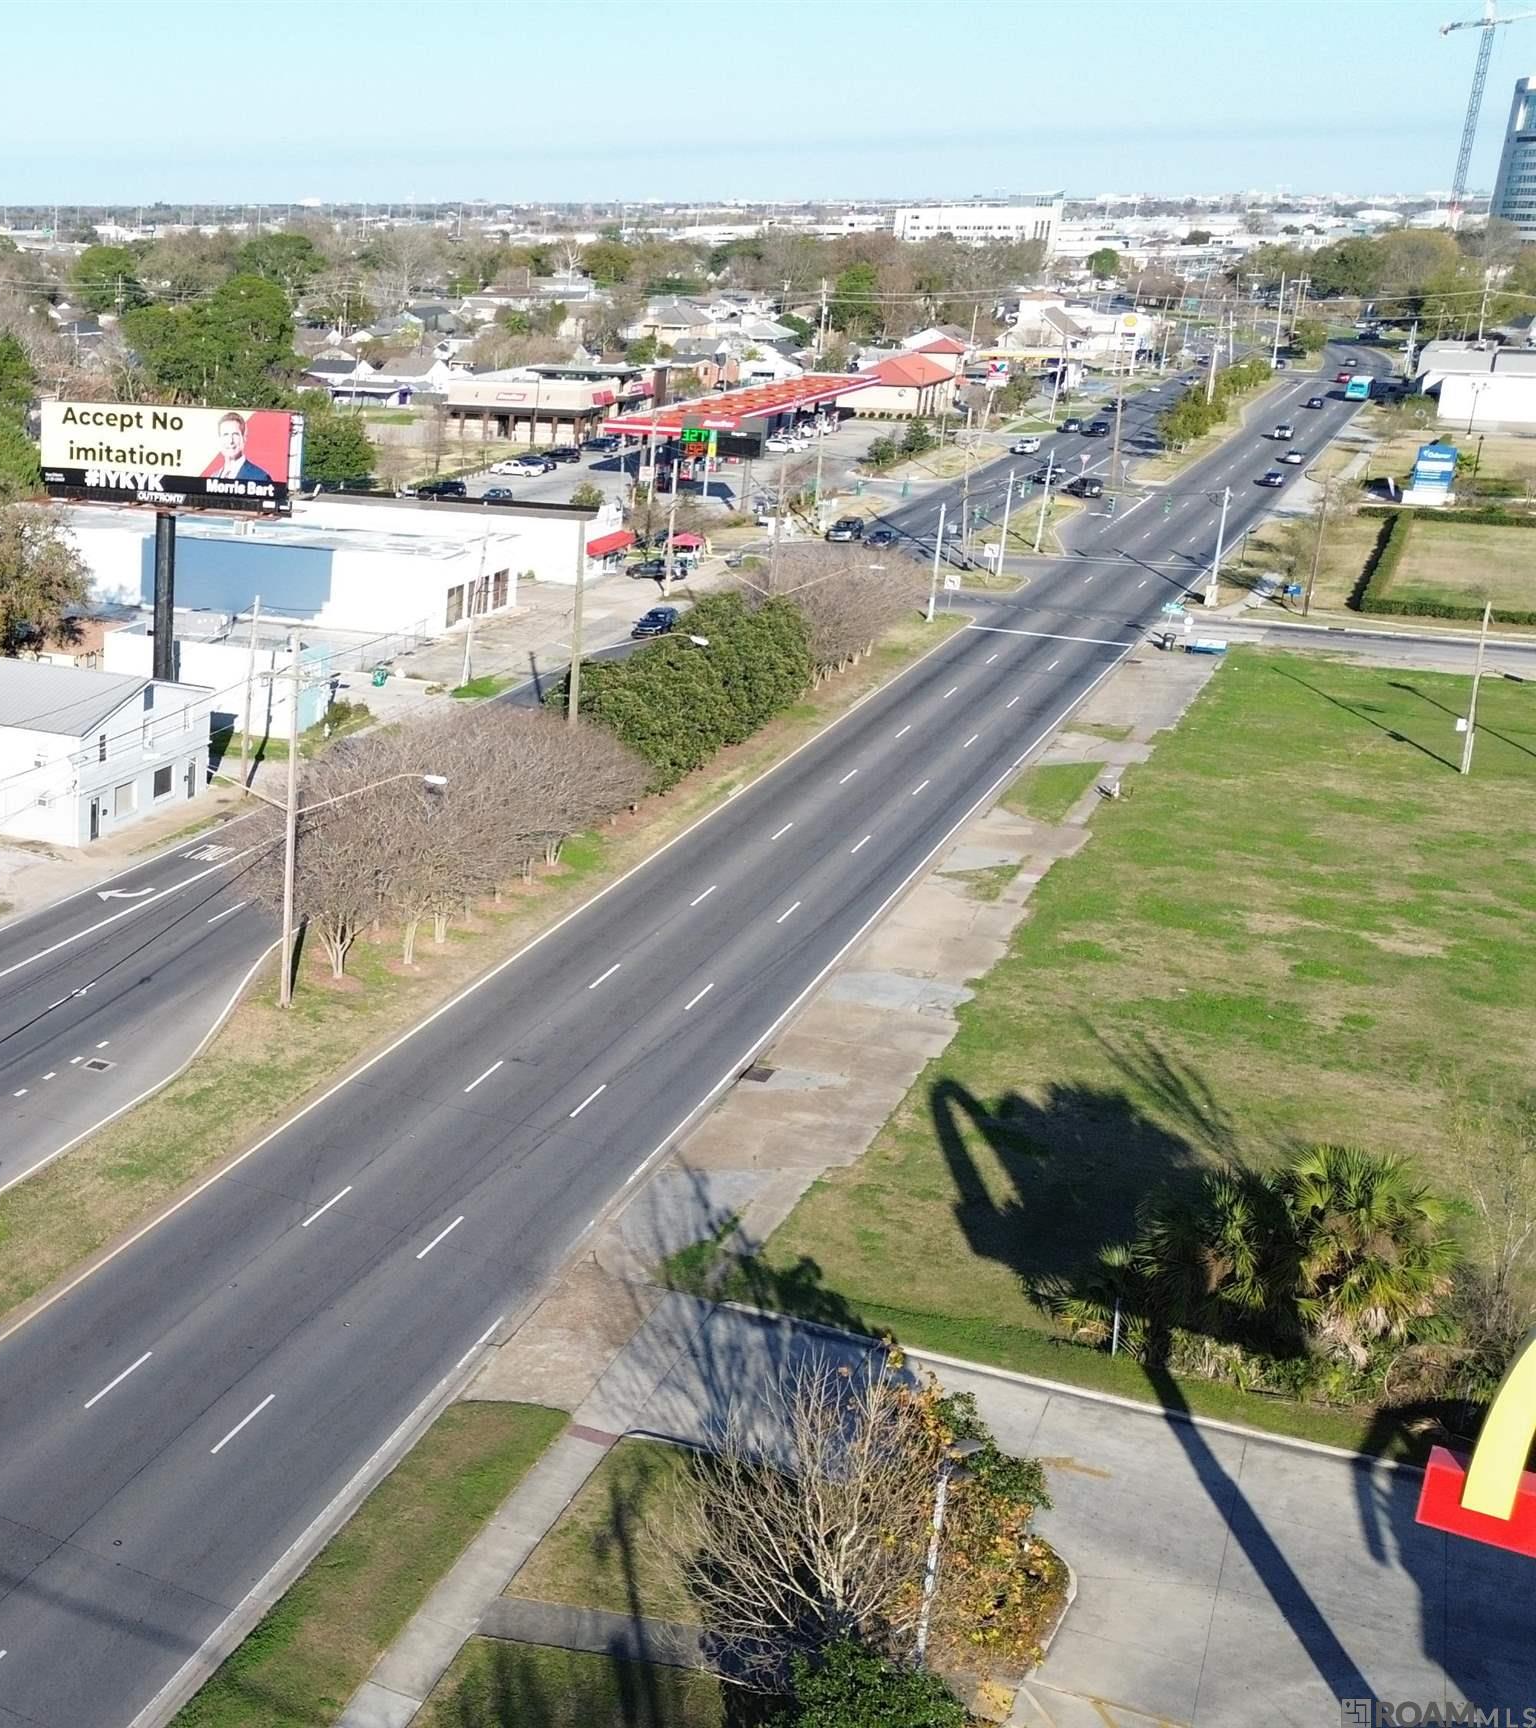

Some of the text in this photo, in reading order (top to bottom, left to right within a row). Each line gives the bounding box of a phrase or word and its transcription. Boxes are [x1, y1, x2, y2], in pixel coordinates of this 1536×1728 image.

[62, 406, 184, 432] Accept No
[68, 440, 182, 467] imitation!
[84, 469, 165, 492] #IYKYK
[206, 478, 275, 498] Morris Bart
